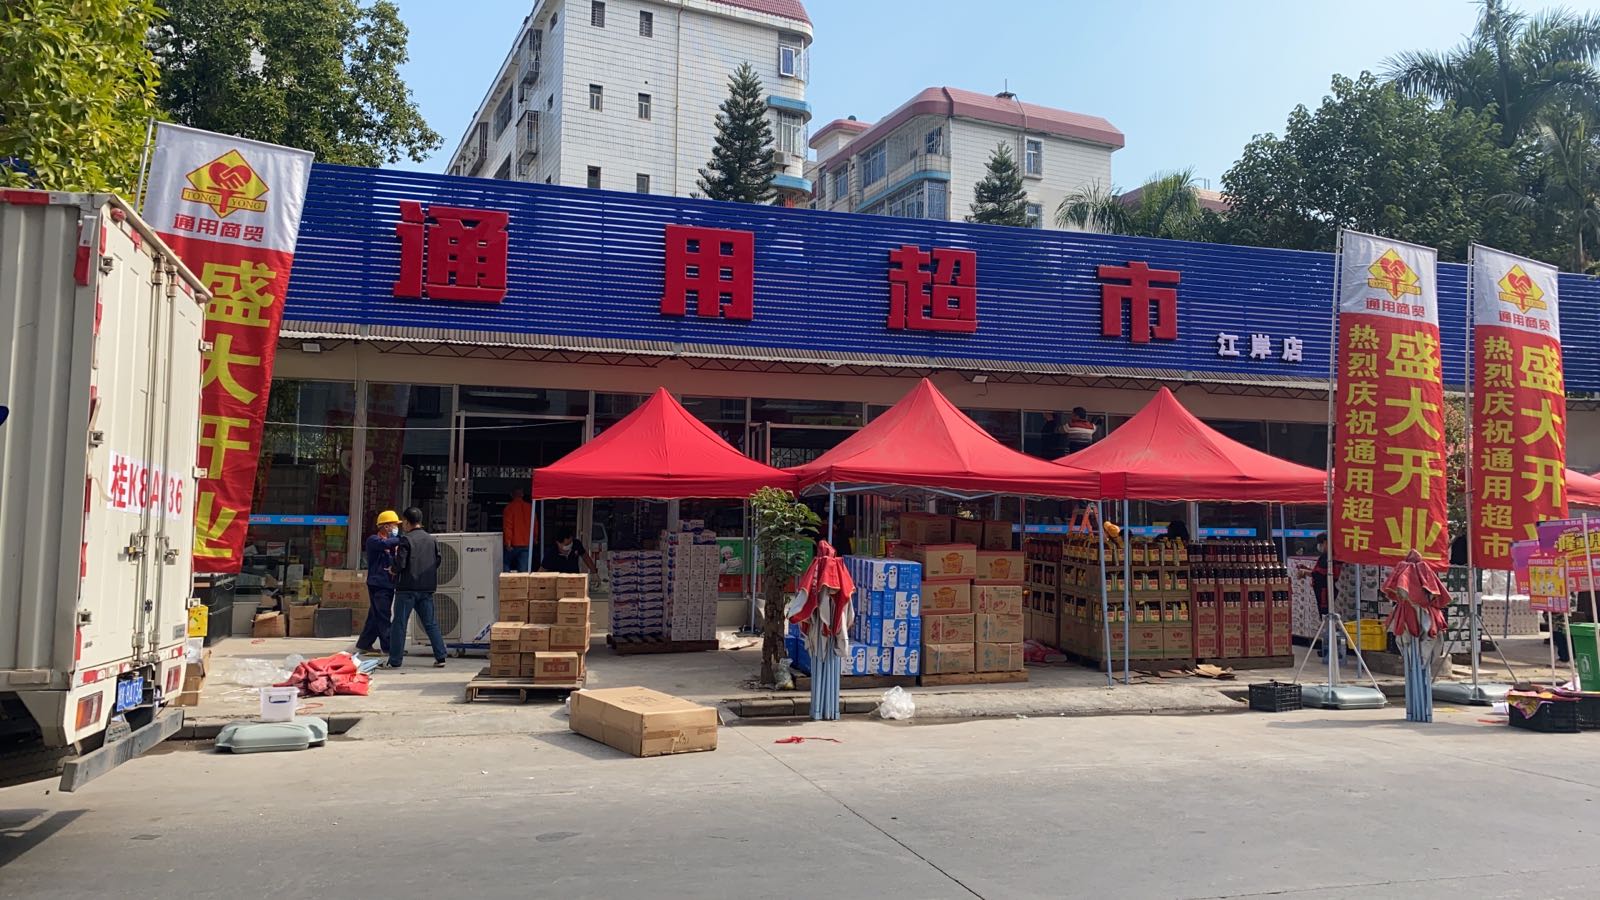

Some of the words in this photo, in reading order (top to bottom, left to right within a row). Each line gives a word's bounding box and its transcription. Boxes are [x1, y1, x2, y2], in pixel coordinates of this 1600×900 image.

[184, 190, 217, 204] TONG
[230, 197, 262, 210] YONG
[173, 212, 265, 243] 通用商贸
[393, 200, 1181, 345] 通用超市
[1365, 297, 1426, 318] 通用商贸
[1498, 310, 1551, 332] 通用商贸
[1217, 332, 1304, 362] 江岸店
[1340, 323, 1380, 552] 热烈庆祝通用超市
[1379, 330, 1443, 561] 盛大开业
[1480, 335, 1515, 559] 热烈庆祝通用超市
[110, 454, 184, 515] 桂K8A36
